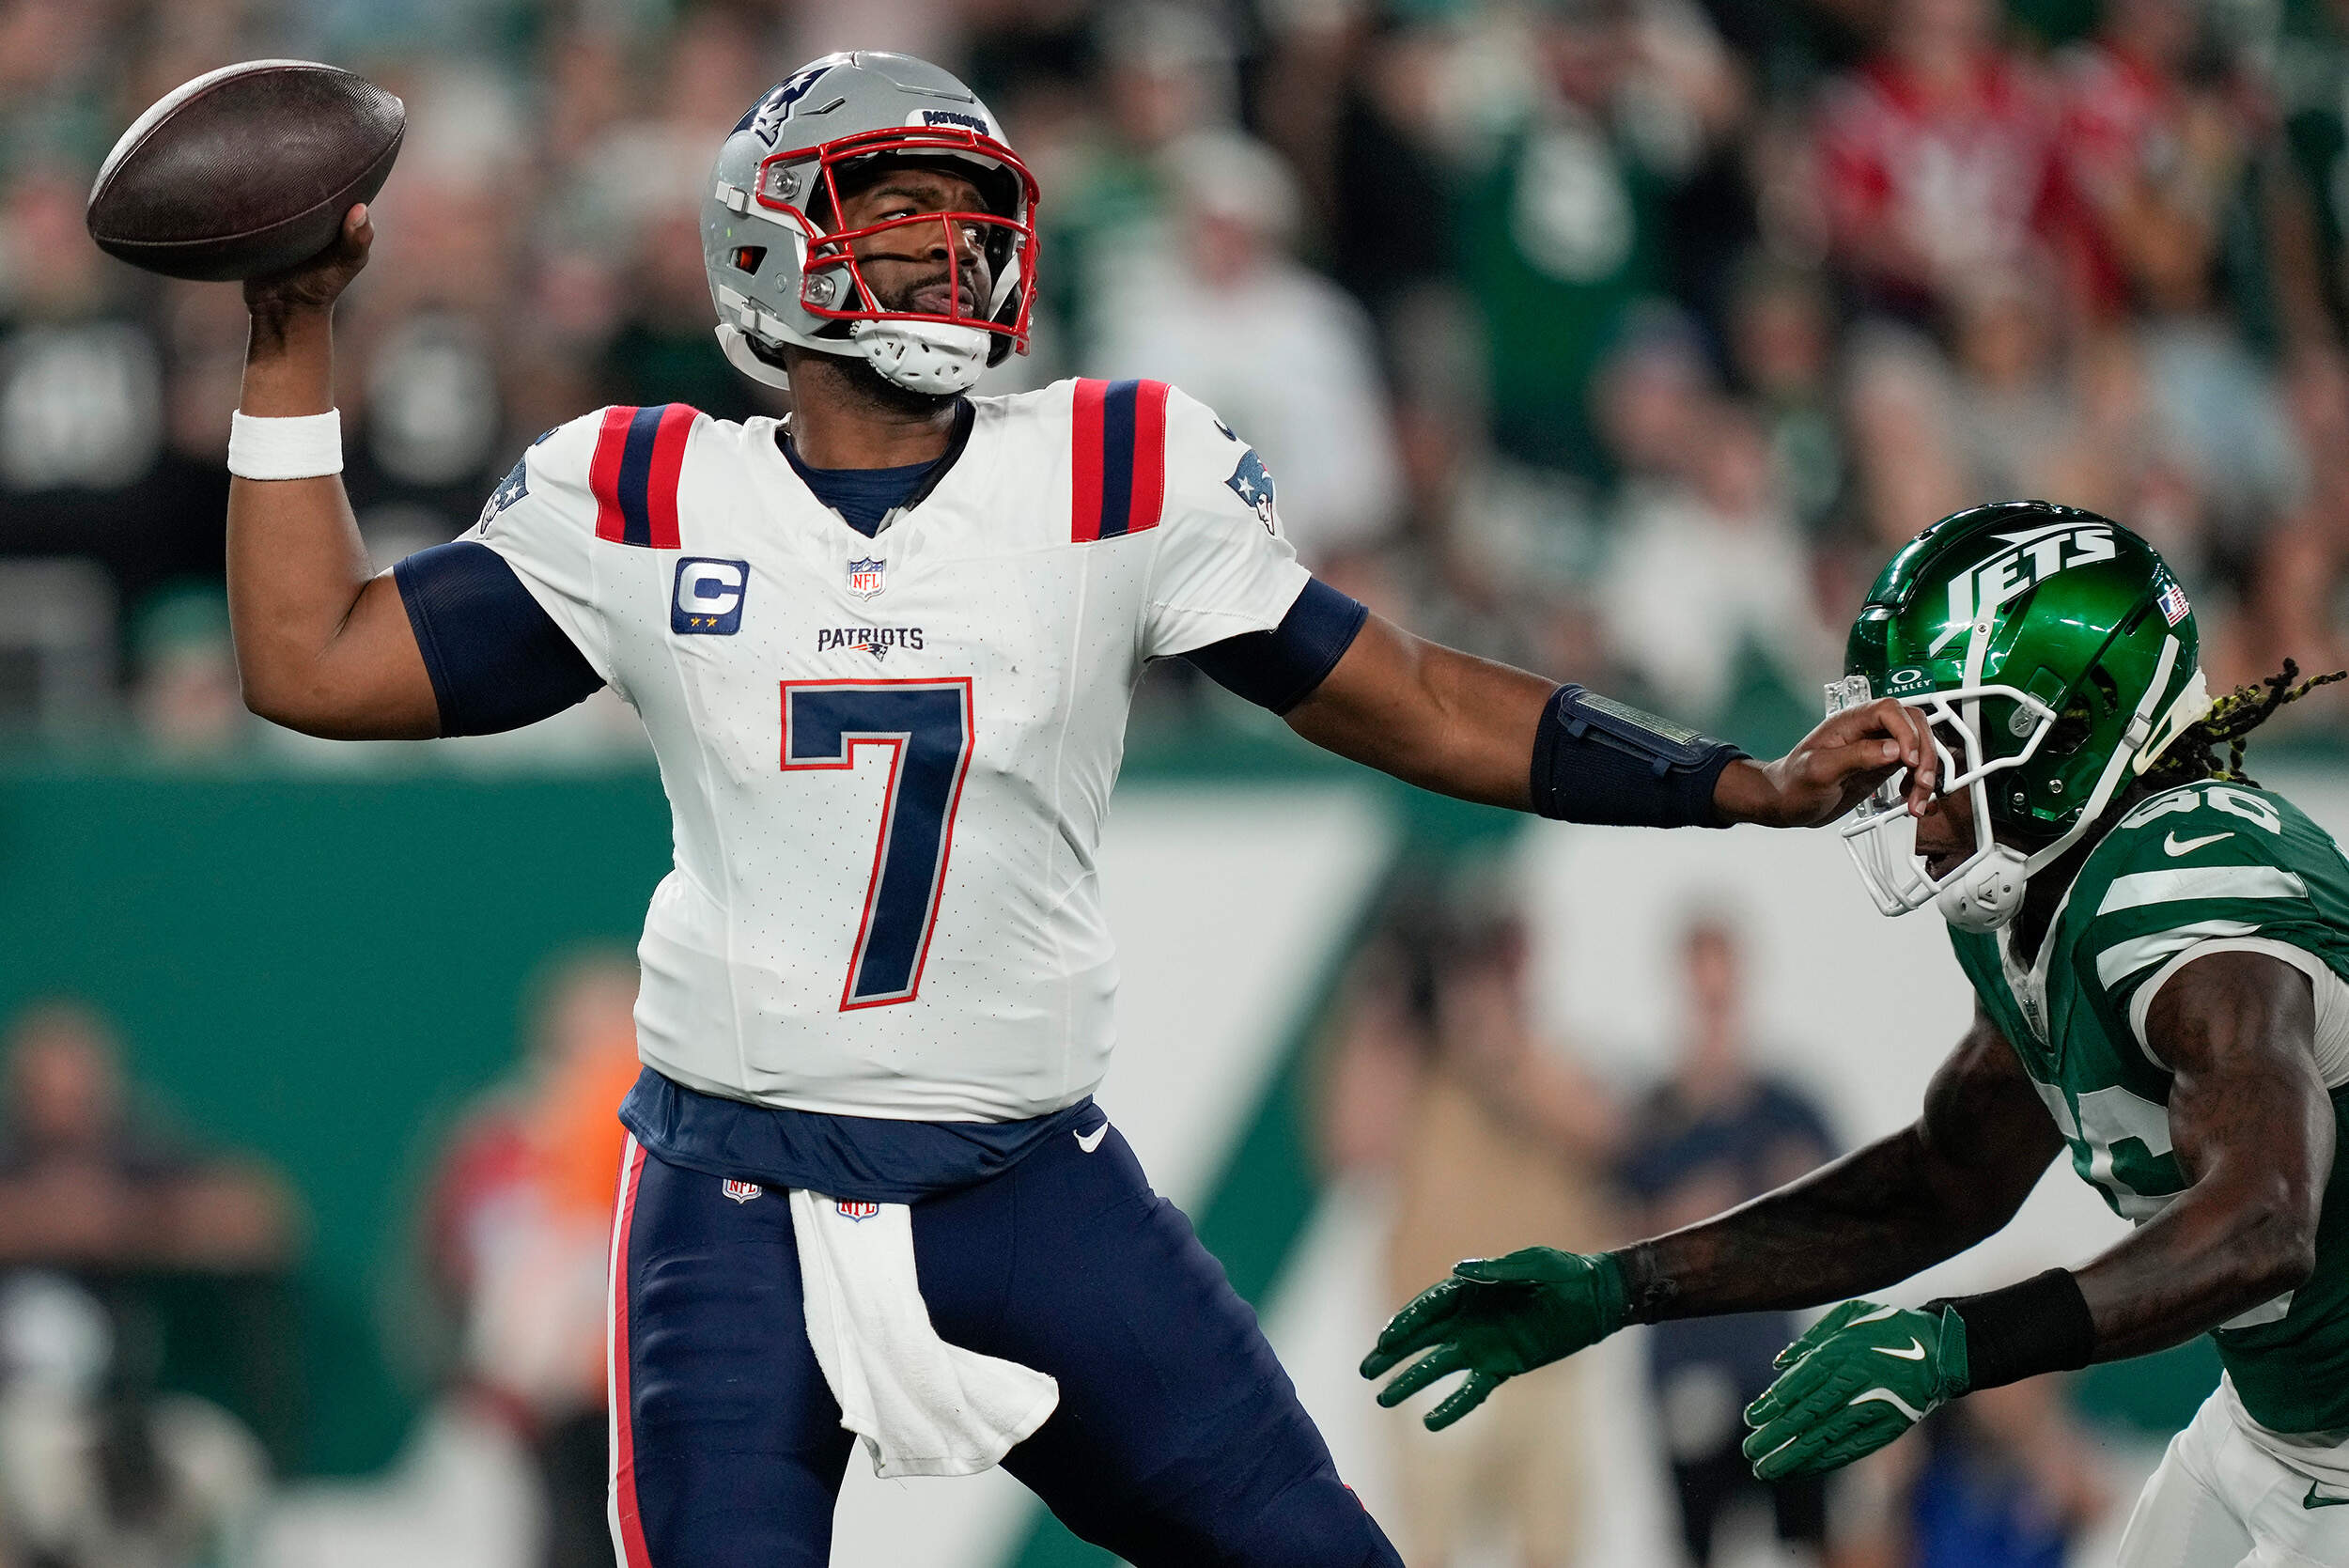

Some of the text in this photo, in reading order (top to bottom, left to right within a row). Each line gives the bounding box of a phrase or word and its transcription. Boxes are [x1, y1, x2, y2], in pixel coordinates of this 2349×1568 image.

[677, 562, 742, 615] C
[853, 573, 879, 591] NFL
[1929, 522, 2116, 659] JETS
[817, 628, 924, 652] PATRIOTS
[1886, 678, 1933, 695] OAKLEY
[780, 676, 974, 1012] 7
